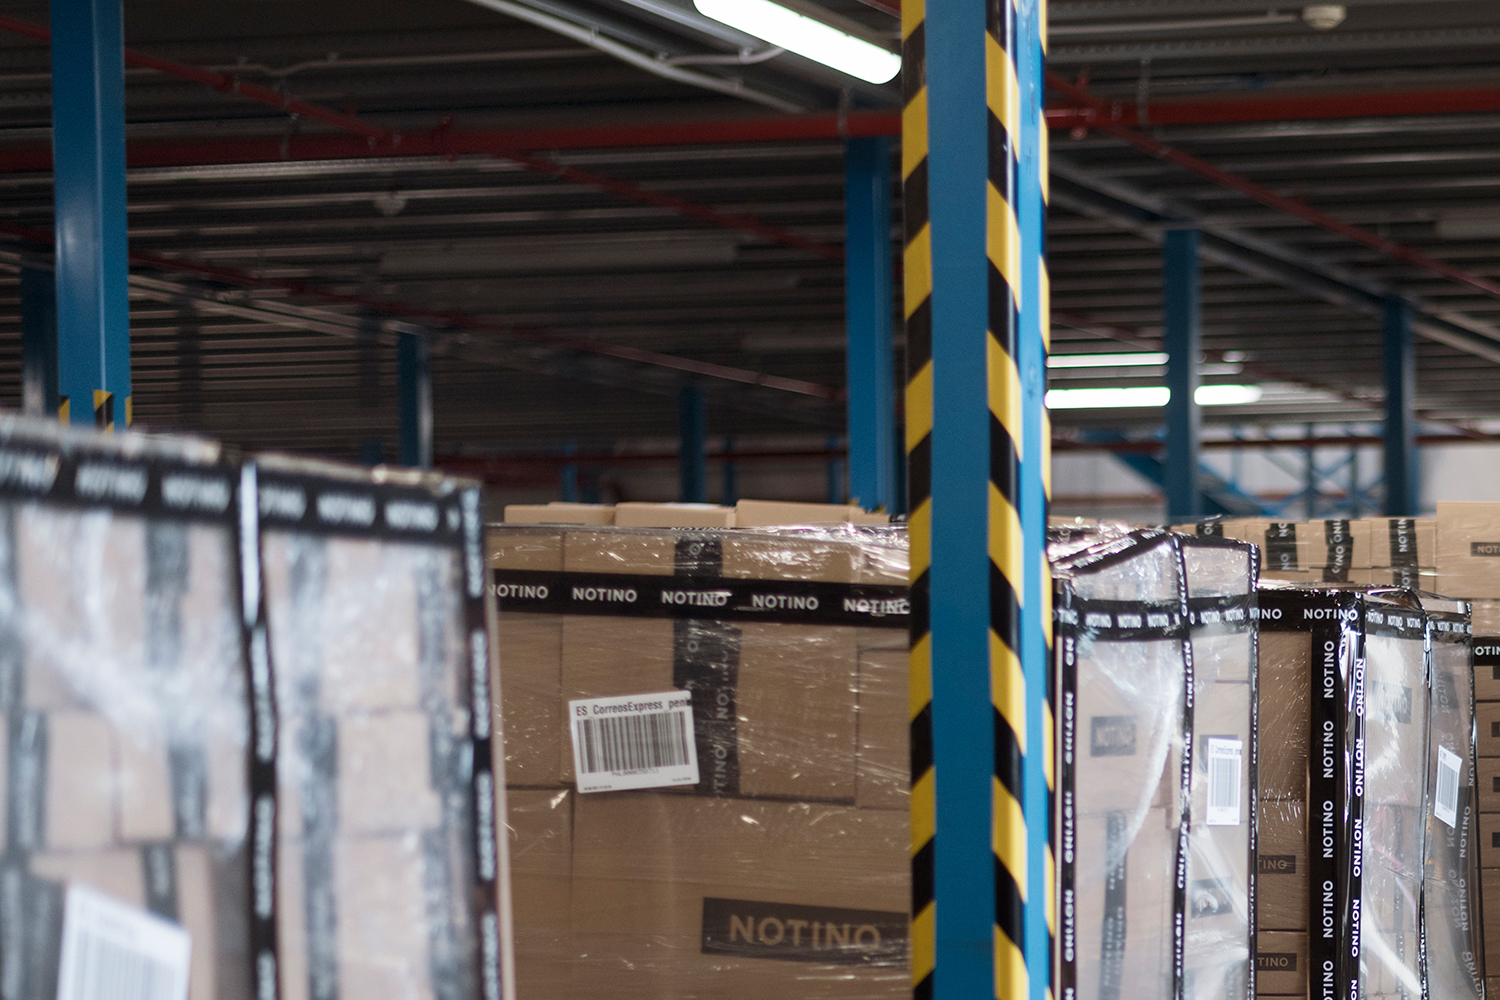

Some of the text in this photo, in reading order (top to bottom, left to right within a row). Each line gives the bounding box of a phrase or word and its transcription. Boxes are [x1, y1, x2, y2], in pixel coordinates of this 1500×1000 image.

[573, 587, 637, 603] NOTINO
[661, 590, 728, 607] NOTINO
[752, 594, 819, 610] NOTINO
[1303, 608, 1358, 620] NOTINO
[1323, 640, 1335, 779] NOTINO NOTINO
[1355, 658, 1364, 797] NOTINO NOTINO
[1322, 800, 1334, 858] NOTINO
[1353, 818, 1362, 877] NOTINO
[730, 915, 881, 951] NOTINO
[1322, 880, 1334, 938] NOTINO
[1351, 899, 1360, 958] NOTINO
